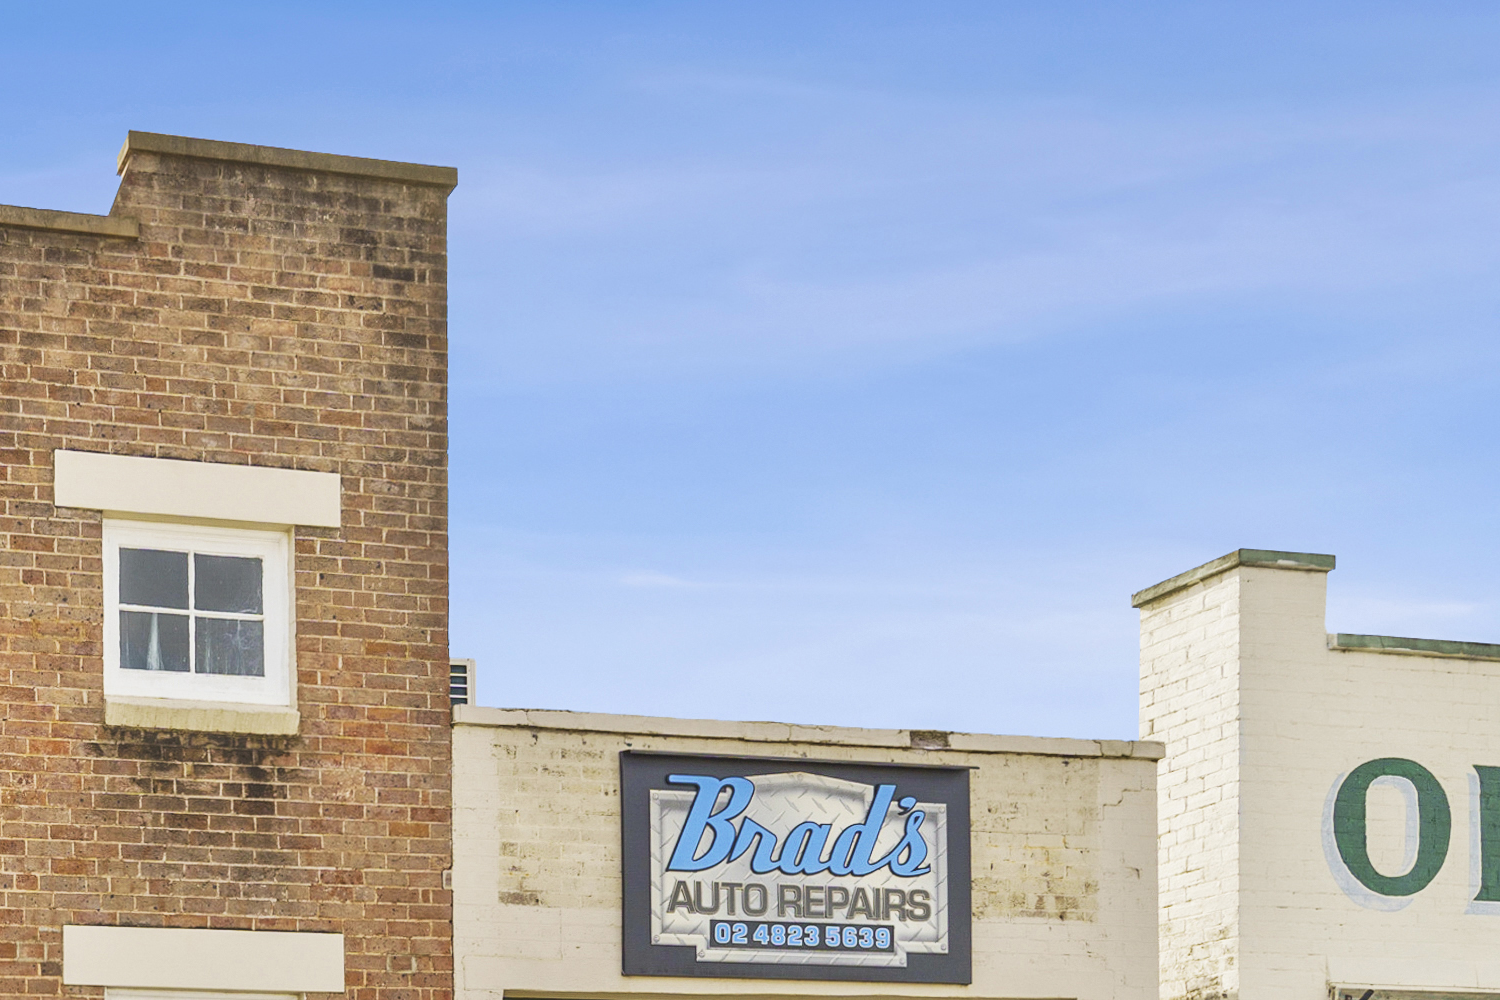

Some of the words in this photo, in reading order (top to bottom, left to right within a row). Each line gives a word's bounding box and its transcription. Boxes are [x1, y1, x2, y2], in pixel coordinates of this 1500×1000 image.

[665, 774, 931, 878] Brad's
[1332, 757, 1500, 902] O
[666, 880, 769, 918] AUTO
[776, 883, 932, 923] REPAIRS
[714, 922, 748, 944] 02
[752, 924, 820, 947] 4823
[824, 926, 890, 949] 5639
